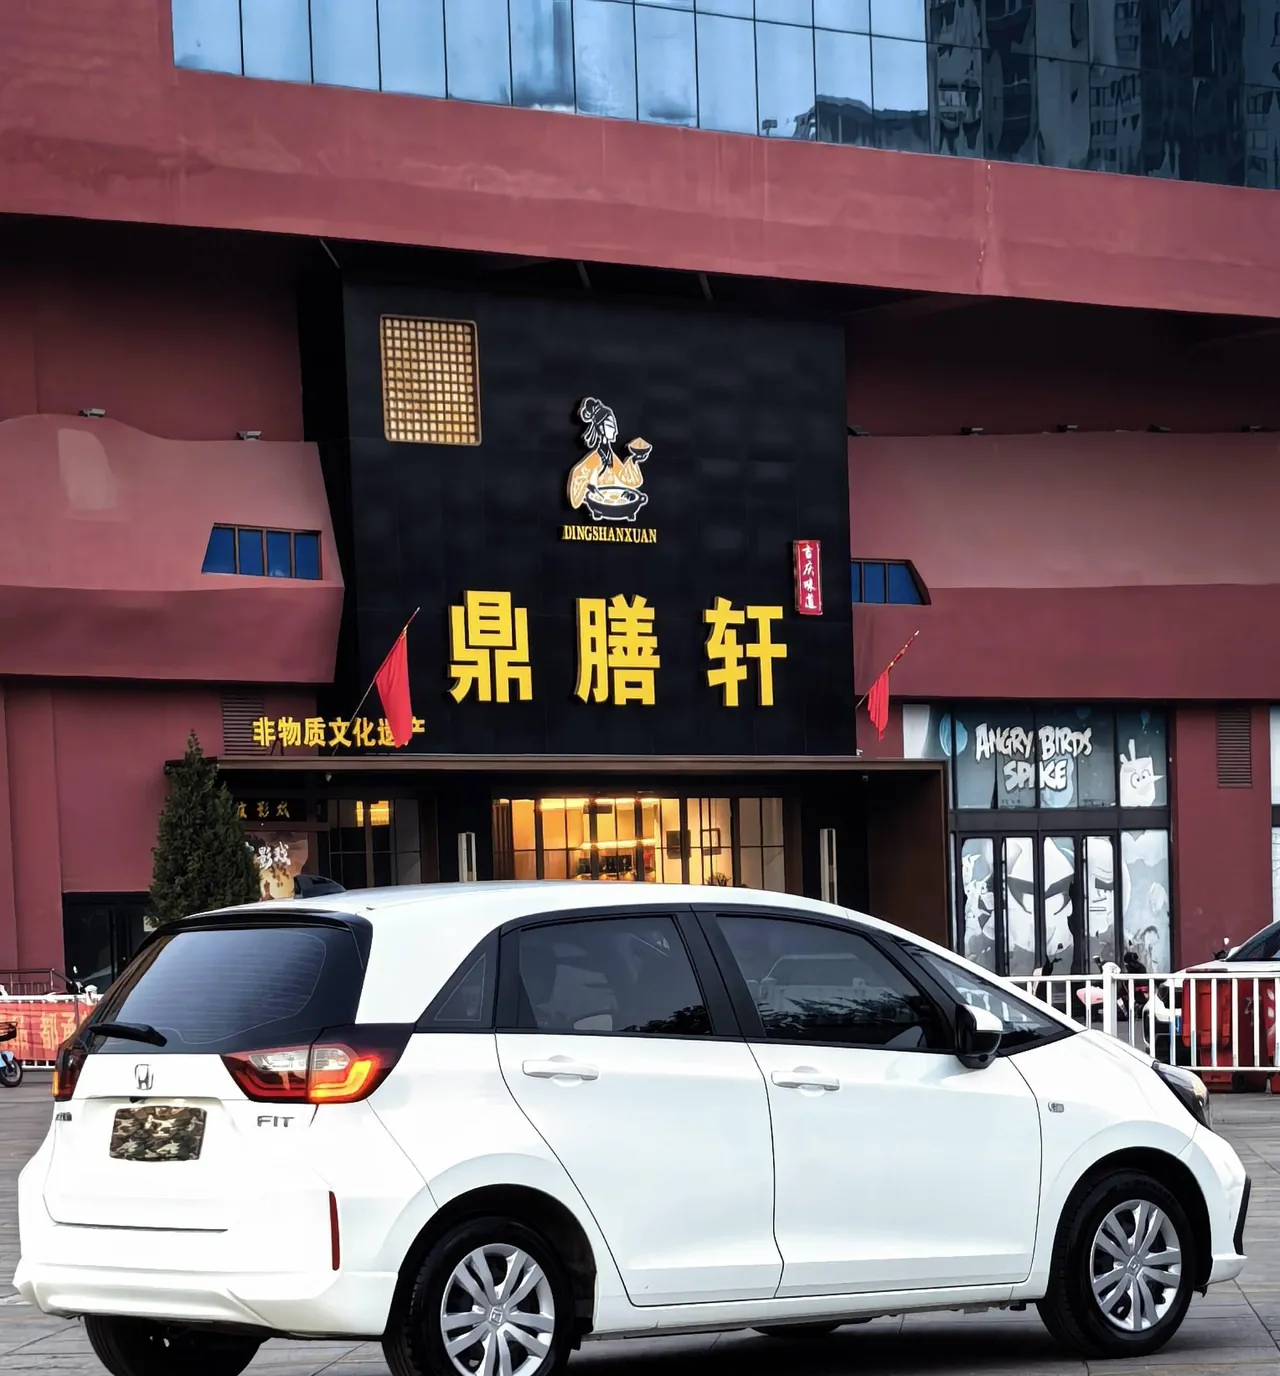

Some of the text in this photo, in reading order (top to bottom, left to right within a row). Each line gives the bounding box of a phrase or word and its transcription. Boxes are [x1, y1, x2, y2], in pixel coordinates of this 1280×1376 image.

[562, 525, 657, 544] DINGSHANXUAN
[449, 590, 787, 706] 鼎膳轩
[975, 722, 1093, 762] ANGRY BIRDS
[245, 841, 291, 870] 影戏
[257, 1115, 295, 1128] FIT
